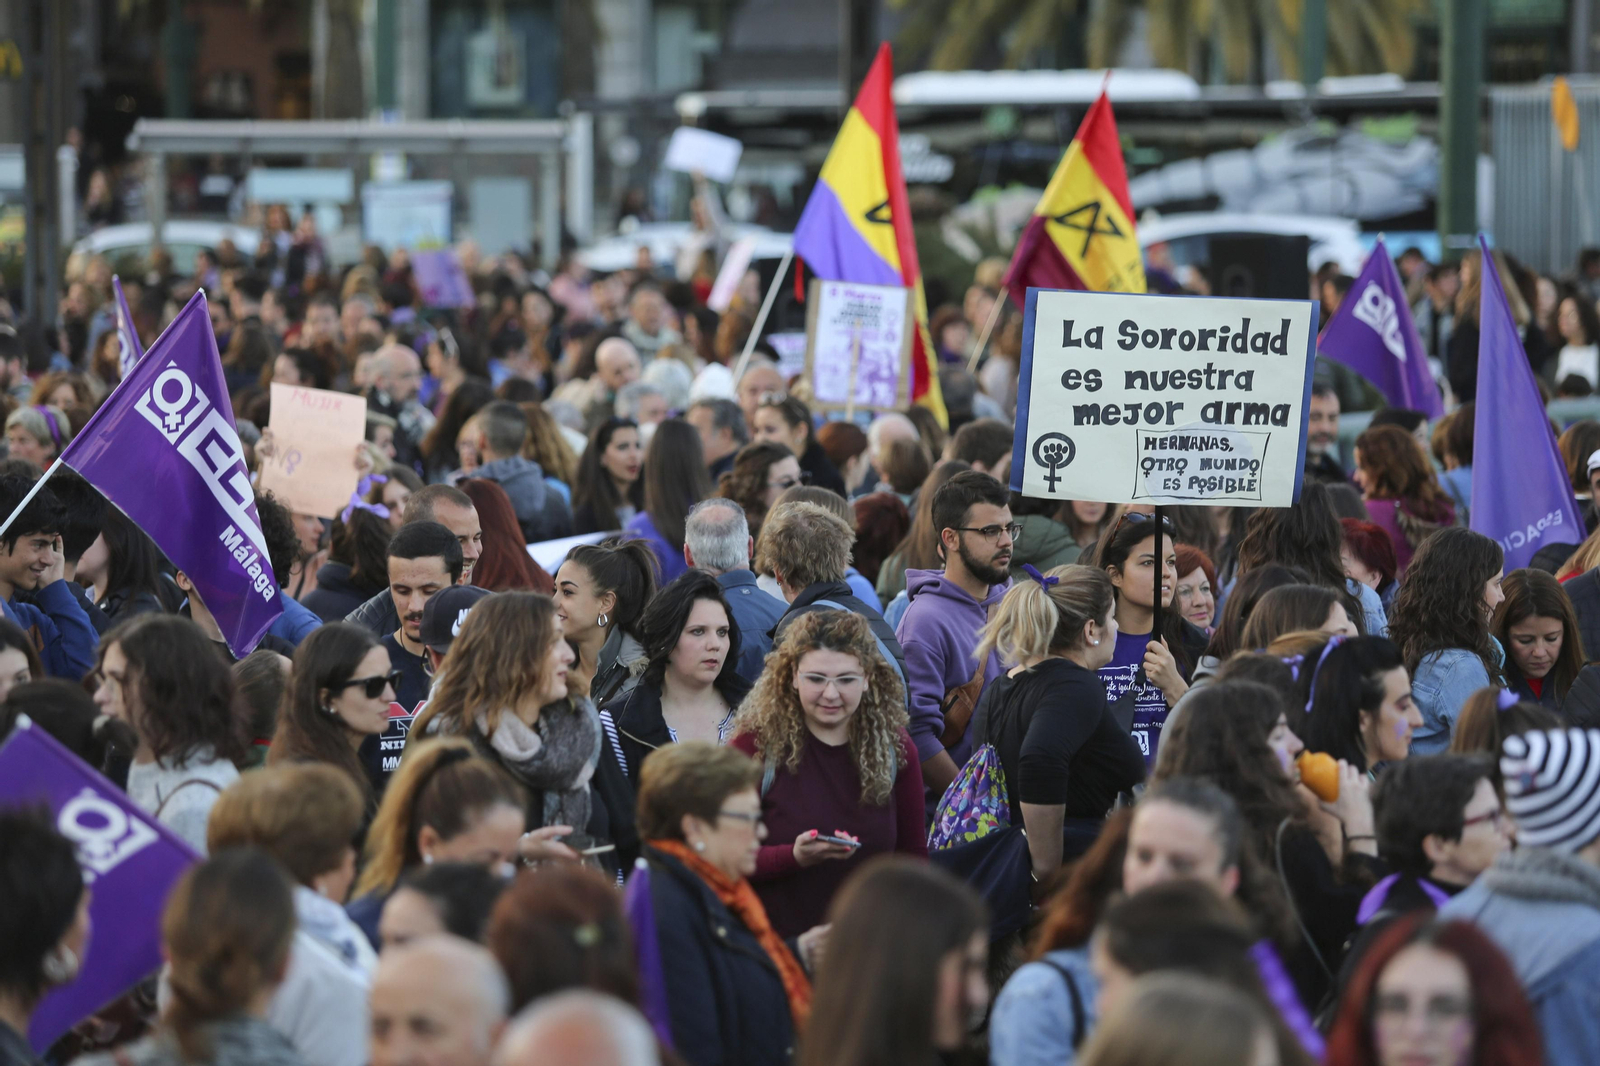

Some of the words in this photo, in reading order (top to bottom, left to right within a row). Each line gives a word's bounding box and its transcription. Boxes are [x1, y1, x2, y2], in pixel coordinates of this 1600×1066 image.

[1062, 319, 1104, 350] La
[1117, 318, 1291, 356] Sororidad
[1061, 368, 1103, 392] es
[1124, 363, 1255, 392] nuestra
[1200, 401, 1291, 427] arma
[1144, 436, 1234, 452] HERMANAS,
[1140, 457, 1188, 478] OTRO
[1199, 457, 1260, 477] MUNDO
[1163, 477, 1181, 490] ES
[219, 524, 275, 602] Málaga
